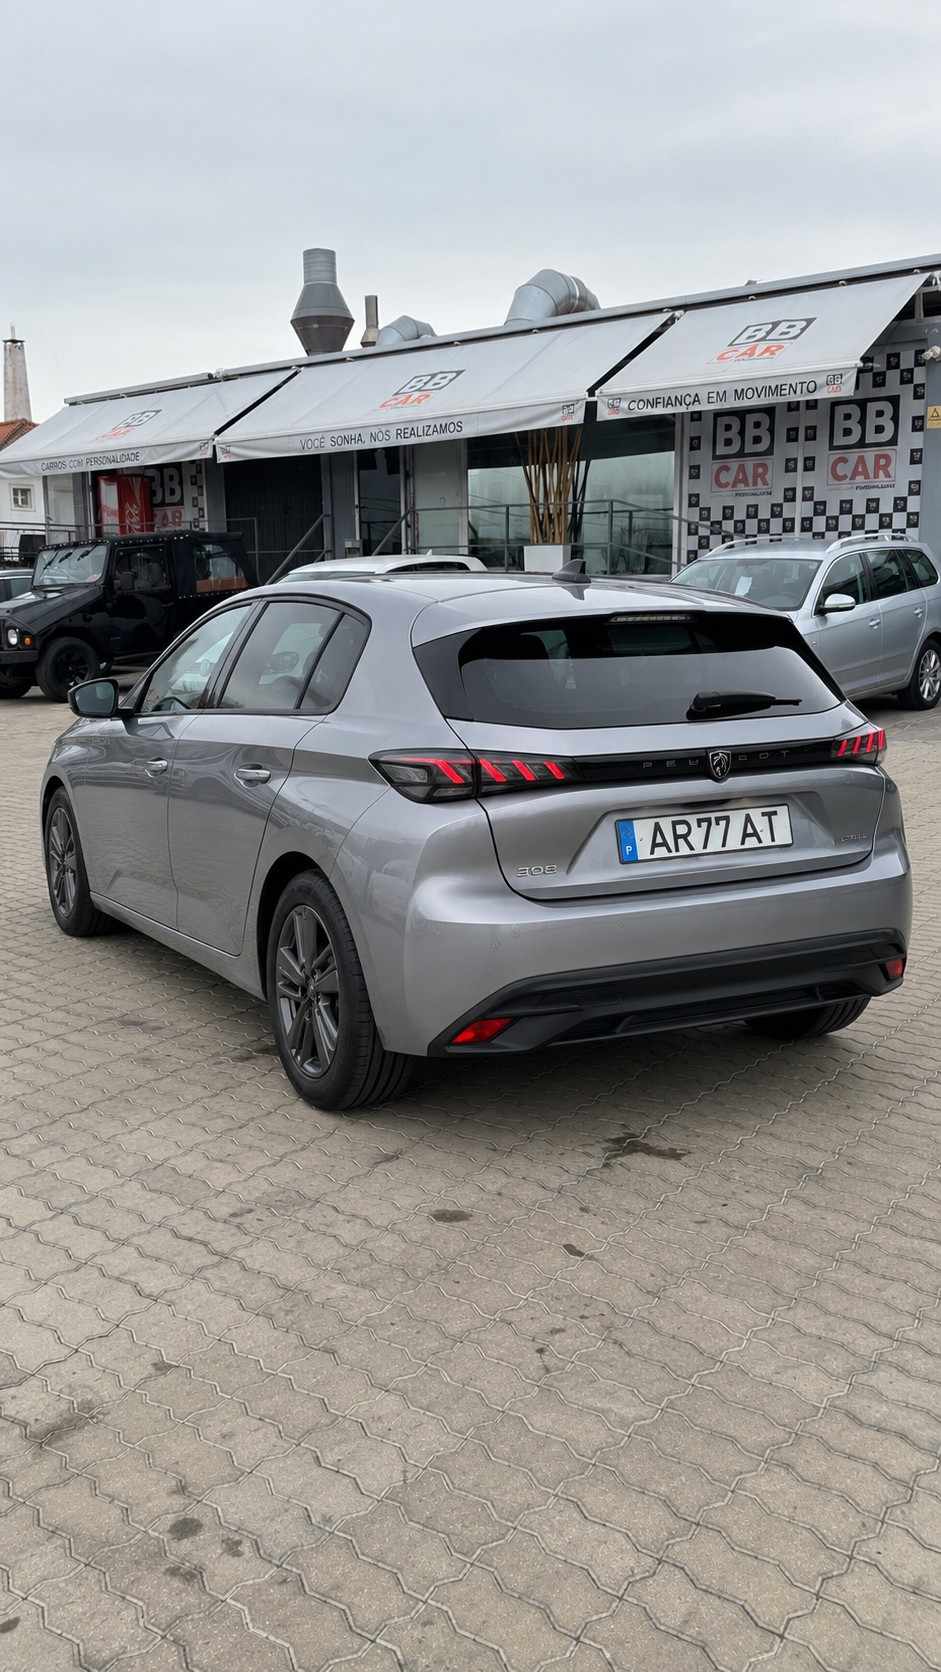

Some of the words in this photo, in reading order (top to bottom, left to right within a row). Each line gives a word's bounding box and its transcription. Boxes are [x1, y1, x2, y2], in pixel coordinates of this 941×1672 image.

[728, 317, 816, 347] BB
[716, 343, 784, 361] CAR
[392, 369, 466, 396] BB
[627, 394, 701, 411] CONFIANÇA
[707, 390, 728, 404] EM
[734, 379, 818, 402] MOVIMENTO
[330, 430, 366, 448] SONHA,
[395, 420, 463, 440] REALIZAMOS
[715, 412, 771, 456] BB
[832, 400, 894, 447] BB
[41, 460, 66, 472] CARROS
[85, 451, 140, 467] PERSONALIDADE
[830, 452, 893, 482] CAR
[714, 462, 769, 489] CAR
[625, 845, 633, 855] P
[516, 864, 558, 878] 308
